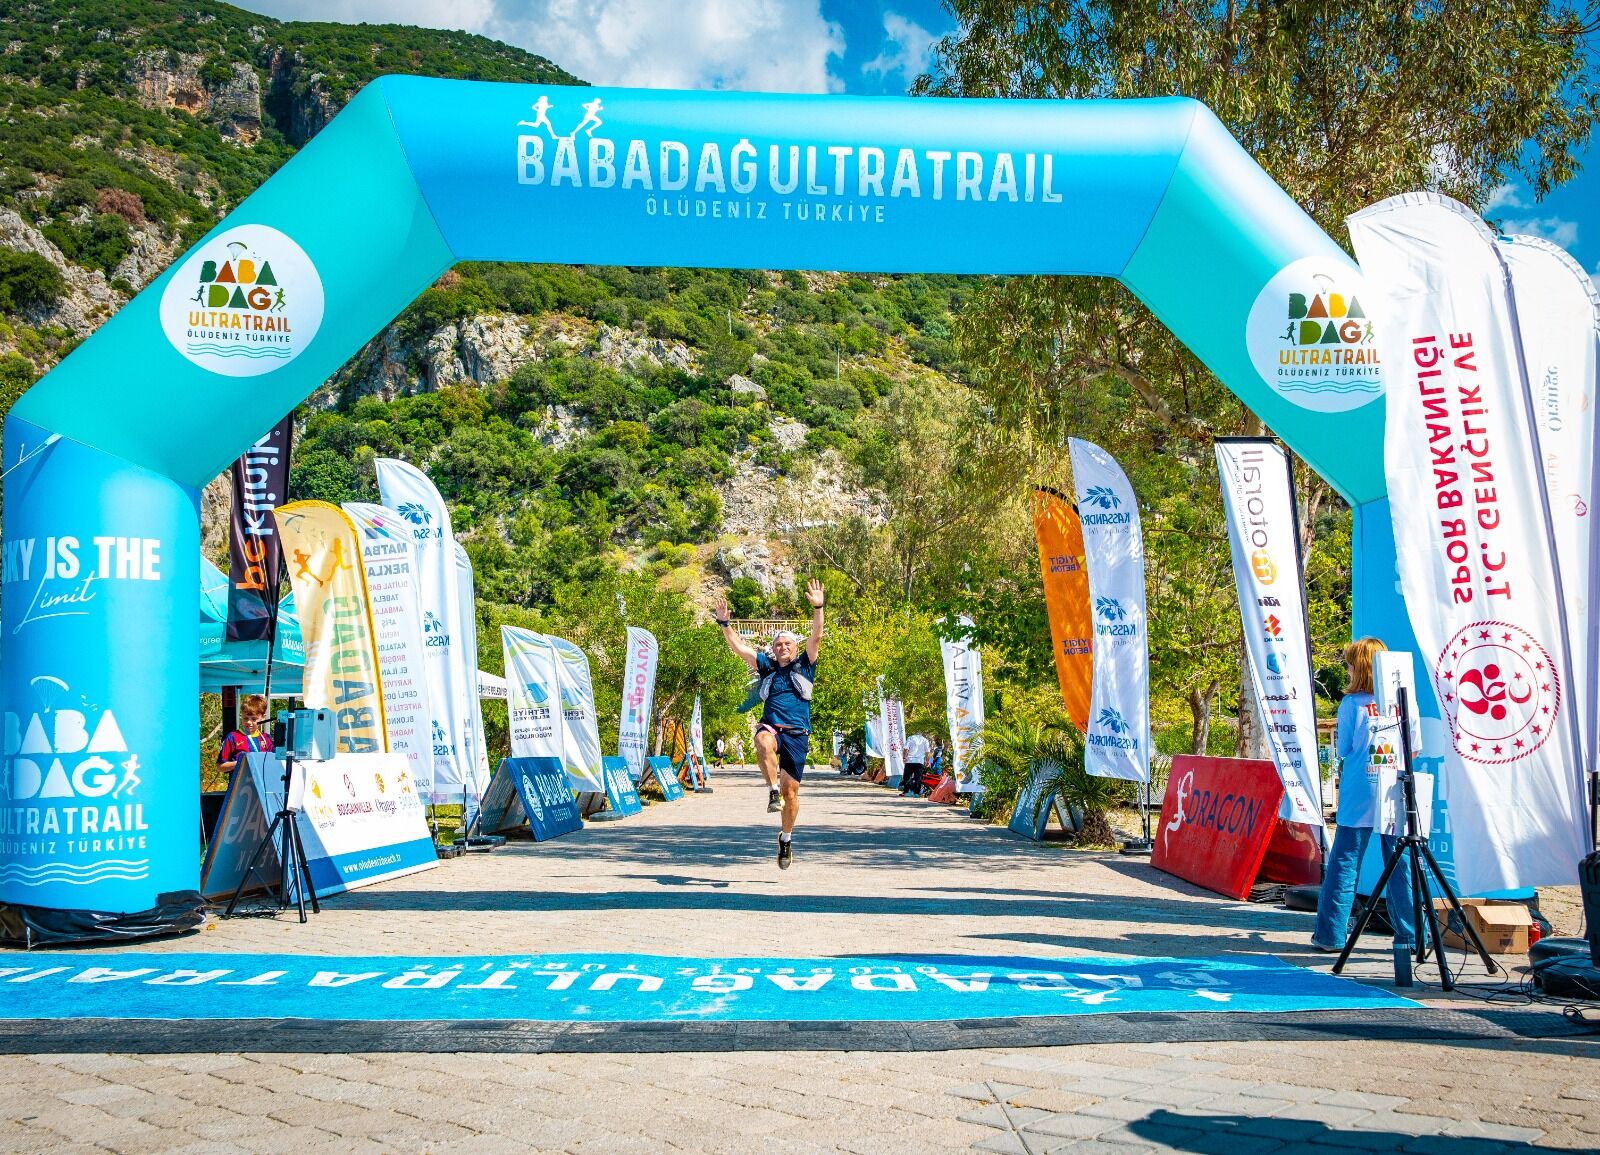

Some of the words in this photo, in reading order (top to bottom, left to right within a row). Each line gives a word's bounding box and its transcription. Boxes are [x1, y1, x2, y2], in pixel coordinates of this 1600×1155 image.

[768, 144, 1063, 204] ULTRATRAIL
[646, 196, 768, 220] ÖLÜDENİZ
[782, 198, 885, 224] TÜRKİYE
[199, 259, 278, 286] BABA
[1288, 293, 1366, 319] BABA
[188, 311, 291, 333] ULTRATRAIL
[246, 333, 290, 343] TÜRKİYE
[1279, 348, 1381, 366] ULTRATRAIL
[1335, 367, 1380, 377] TÜRKİYE
[46, 535, 80, 580] IS
[93, 536, 161, 581] THE
[4, 709, 129, 755] BABA
[67, 836, 147, 853] TÜRKİYE
